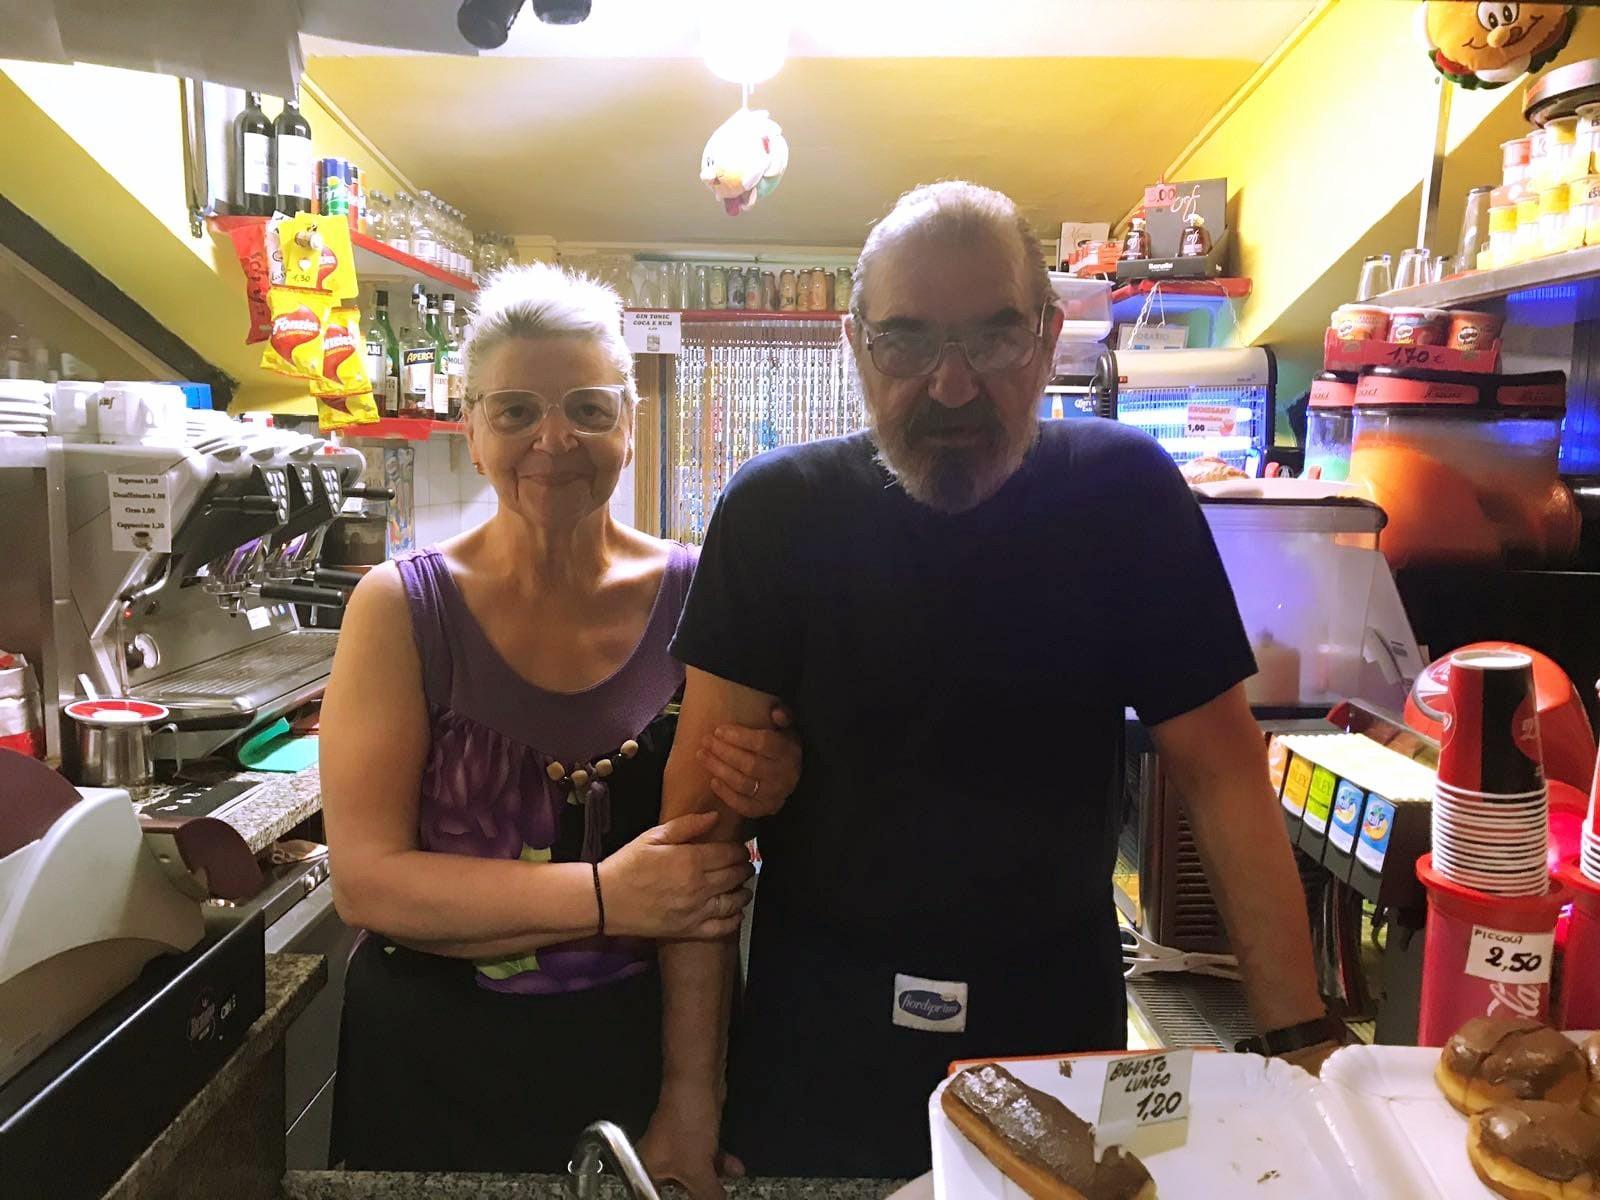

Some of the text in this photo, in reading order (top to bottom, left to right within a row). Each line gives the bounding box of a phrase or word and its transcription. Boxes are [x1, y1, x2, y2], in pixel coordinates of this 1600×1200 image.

[406, 351, 434, 363] APEROL
[1387, 346, 1430, 364] 1,70
[1188, 424, 1205, 432] 1,00
[1485, 946, 1542, 972] 2,50
[1124, 1072, 1172, 1093] LUNGO
[1136, 1091, 1183, 1121] 1,20
